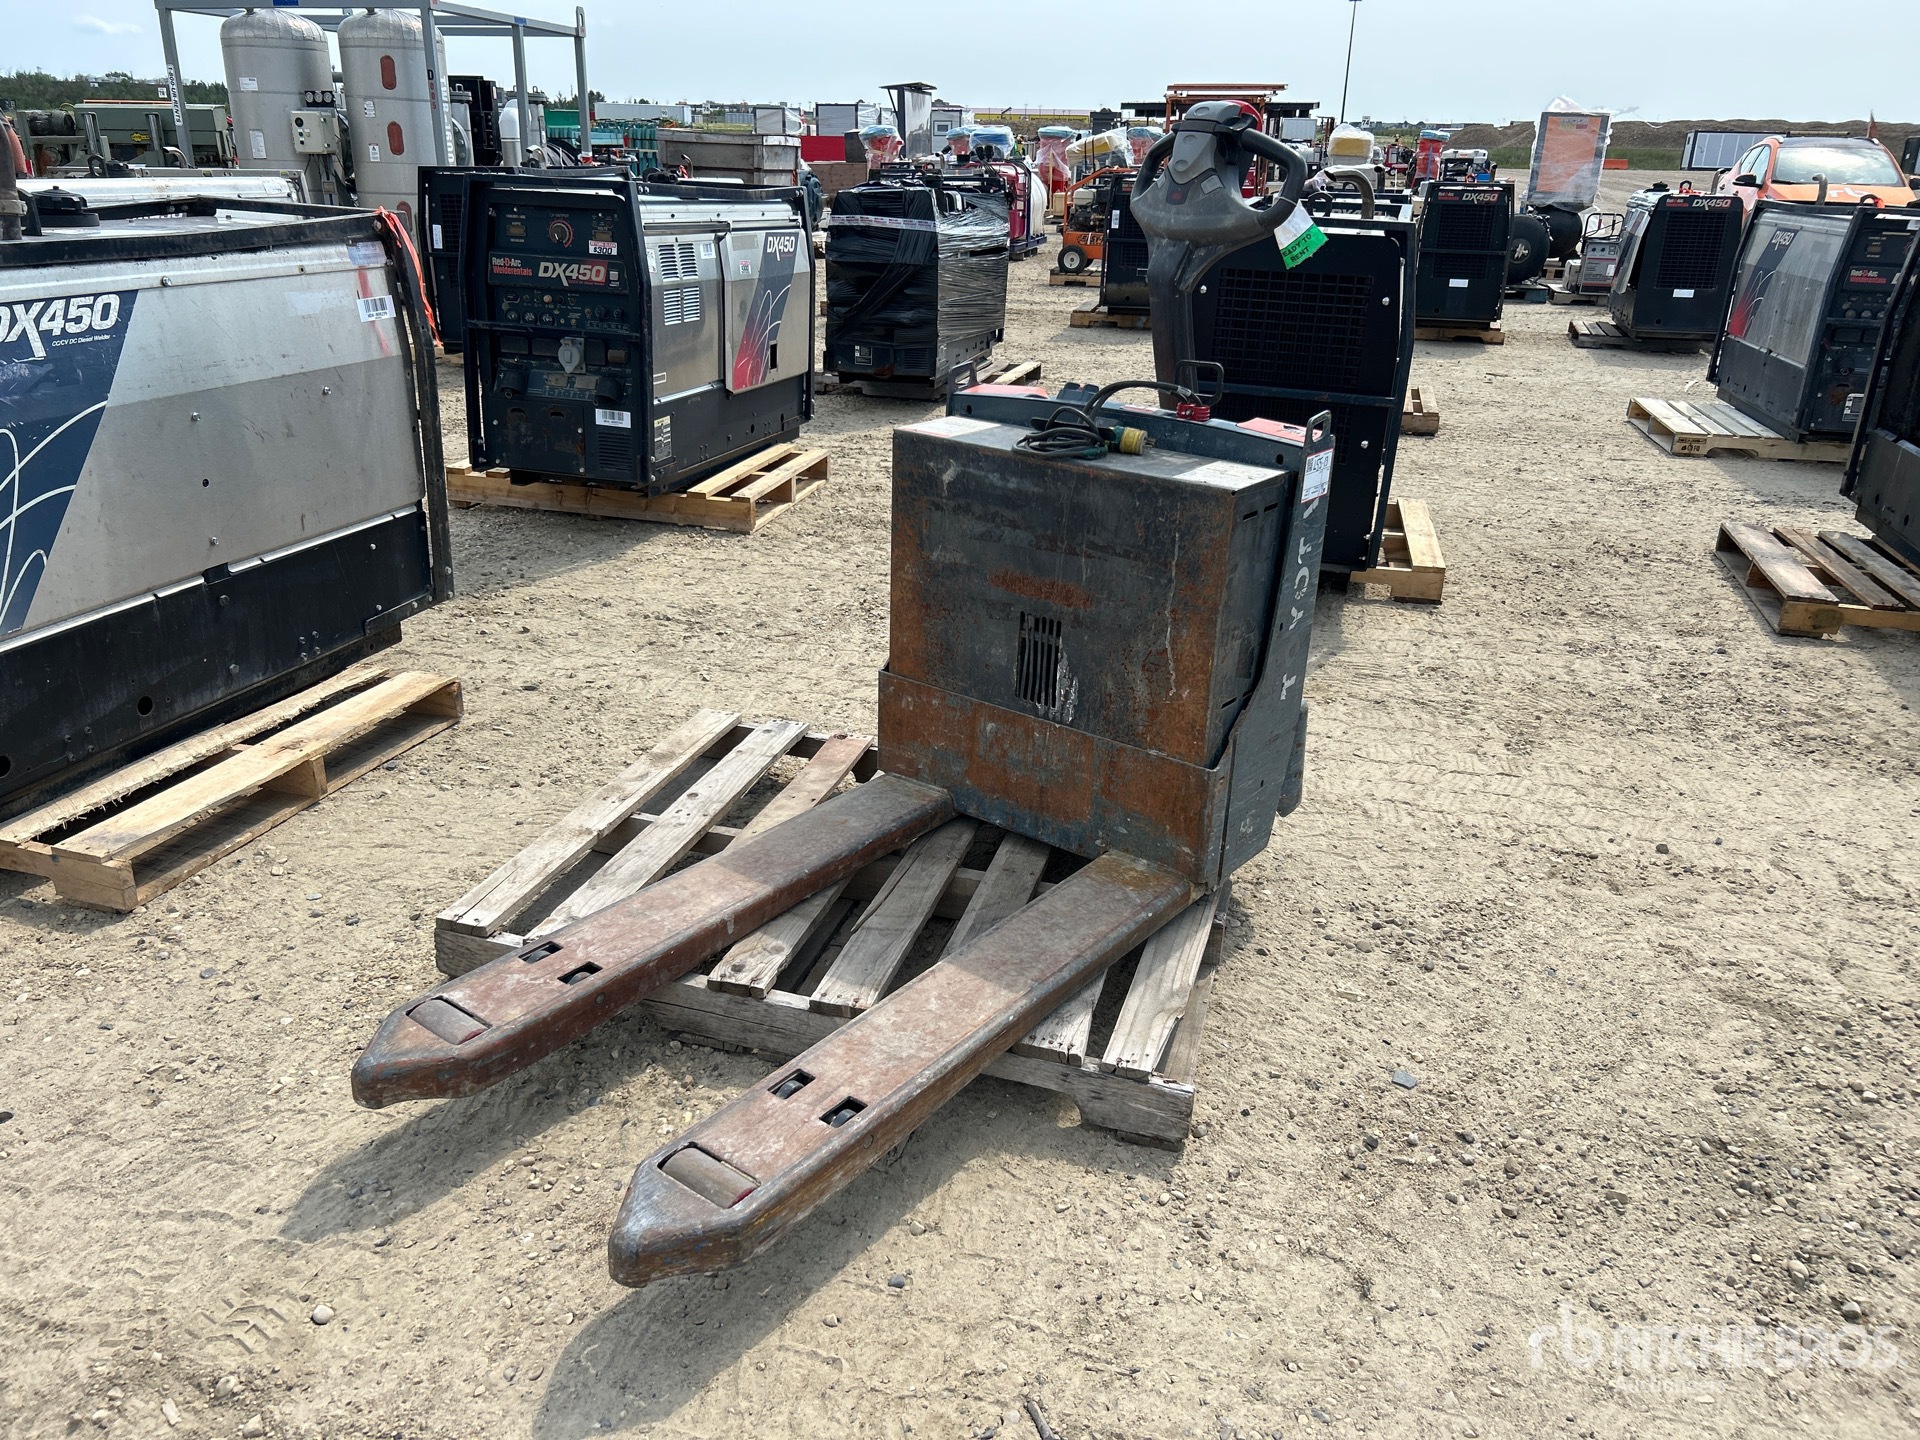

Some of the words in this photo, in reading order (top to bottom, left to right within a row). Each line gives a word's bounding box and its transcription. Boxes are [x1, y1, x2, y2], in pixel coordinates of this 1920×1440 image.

[1462, 192, 1499, 205] DX450
[1692, 198, 1732, 211] DX450
[1282, 241, 1301, 257] EADY
[1302, 233, 1312, 243] TO
[1771, 230, 1795, 250] DX450
[593, 246, 613, 255] $300
[767, 236, 796, 262] DX450
[1290, 246, 1310, 262] RENT
[492, 256, 521, 267] Red-D-Arc
[493, 266, 533, 276] Welderentals
[538, 261, 606, 286] DX450
[78, 335, 94, 343] Diesel
